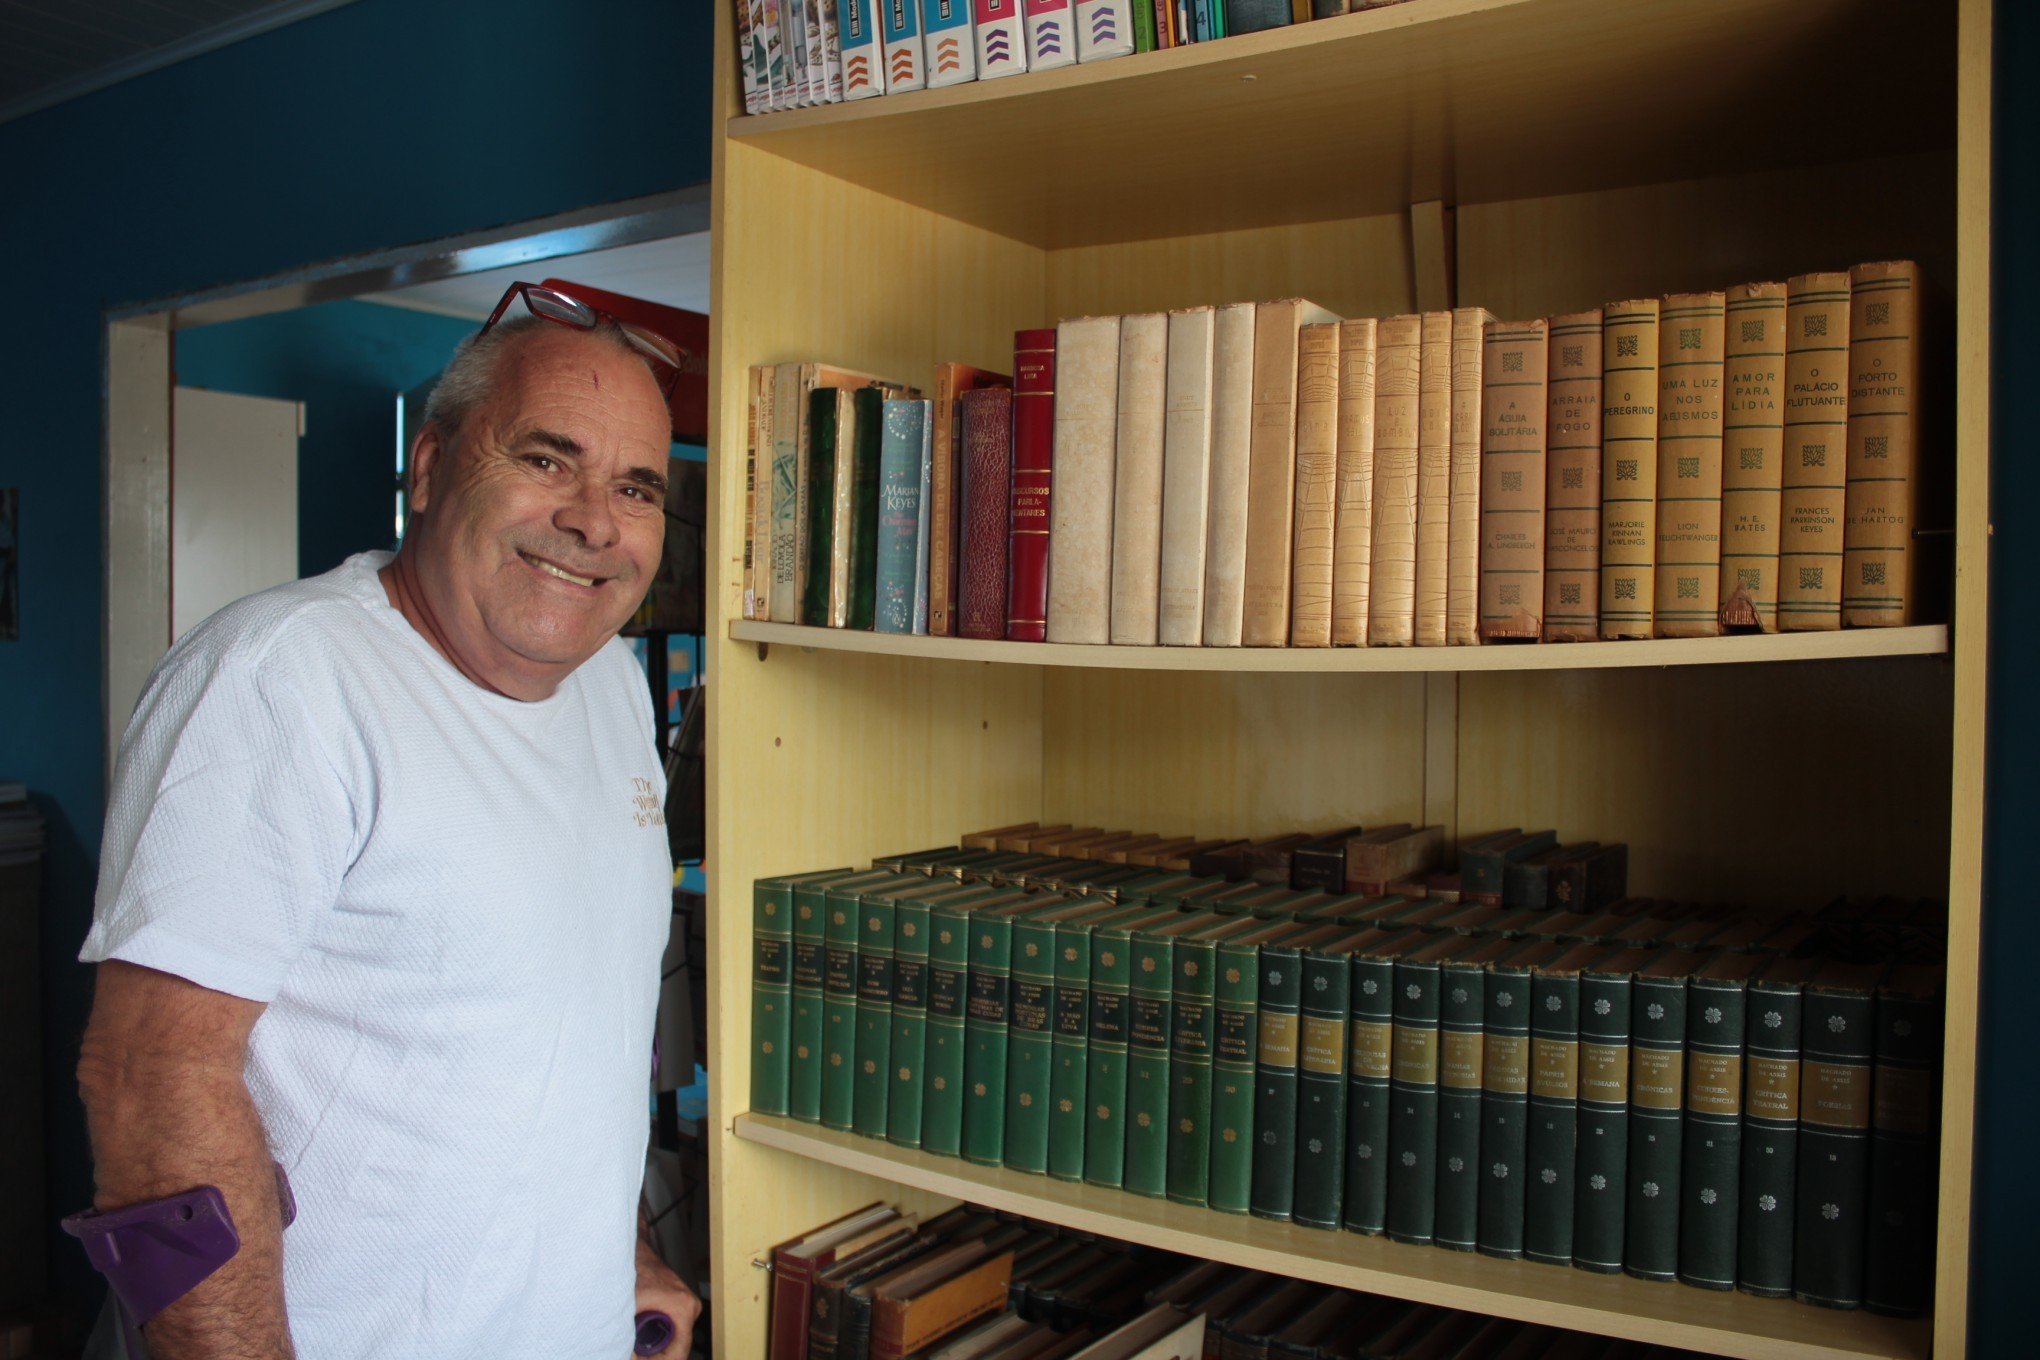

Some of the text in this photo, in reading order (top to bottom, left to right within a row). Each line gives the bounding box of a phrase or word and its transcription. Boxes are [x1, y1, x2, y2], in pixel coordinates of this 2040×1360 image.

[1196, 11, 1206, 26] 4
[1872, 358, 1881, 367] O
[1731, 372, 1775, 383] AMOR
[1810, 368, 1819, 377] O
[1661, 379, 1718, 390] UMA LUZ
[1793, 381, 1839, 393] PALÁCIO
[1624, 392, 1631, 401] O
[1735, 387, 1770, 397] PARA
[1851, 386, 1905, 398] DISTANTE
[1552, 395, 1597, 406] ARRAIA
[1675, 395, 1702, 405] NOS
[1731, 398, 1775, 411] LÍDIA
[1786, 396, 1845, 408] FLUTUANTE
[1565, 410, 1581, 418] DE
[1604, 406, 1655, 417] PEREGRINO
[1661, 411, 1719, 422] ABISMOS
[1488, 426, 1537, 437] SOLITÁRIA
[1556, 422, 1591, 432] FOGO
[933, 428, 947, 599] A VÍBORA DE DEZ CABEÇAS
[1794, 507, 1829, 515] FRANCES
[1864, 506, 1885, 514] JAN
[1790, 516, 1835, 524] PARKINSON
[1860, 515, 1905, 524] HARTOG
[1608, 521, 1646, 529] MARJORIE
[1676, 522, 1699, 531] LION
[1733, 524, 1766, 532] BATES
[1800, 525, 1823, 534] KEYES
[1608, 538, 1646, 547] RAWLINGS
